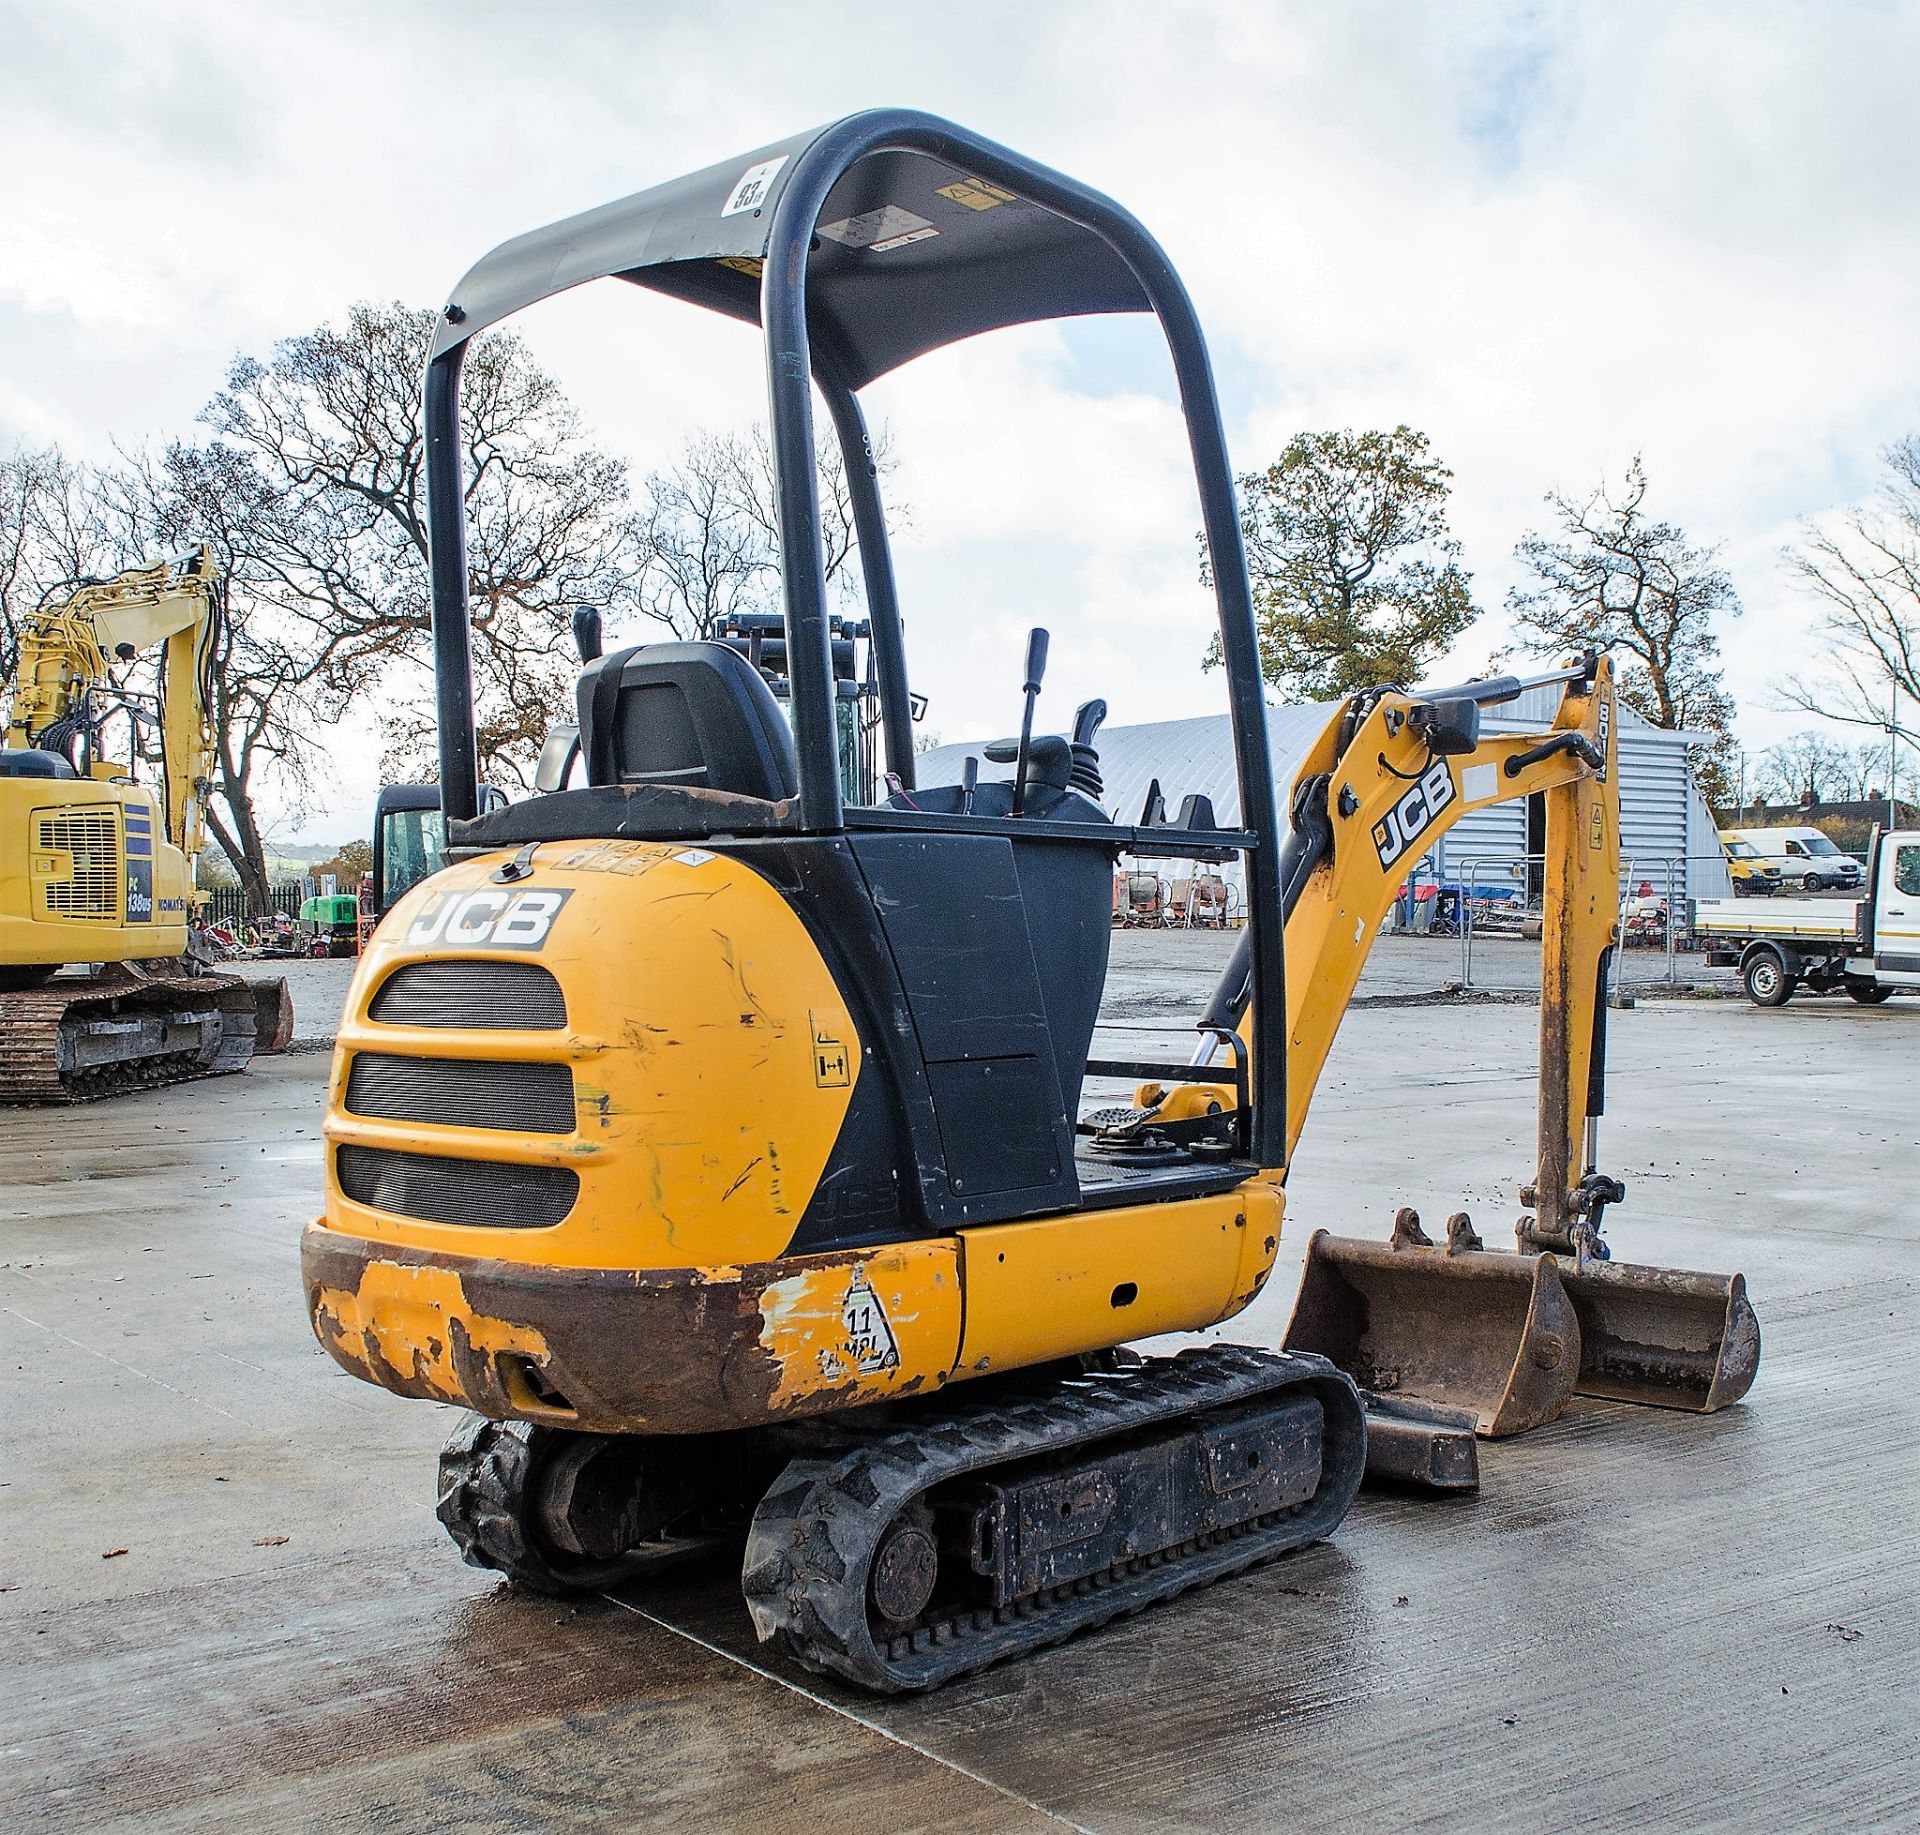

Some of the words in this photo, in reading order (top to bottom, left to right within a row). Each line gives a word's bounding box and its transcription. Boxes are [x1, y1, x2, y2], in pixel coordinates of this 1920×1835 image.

[733, 180, 762, 210] 93
[1379, 761, 1454, 866] JCB
[128, 877, 139, 892] PC
[407, 891, 563, 945] JCB
[847, 1306, 872, 1336] 11
